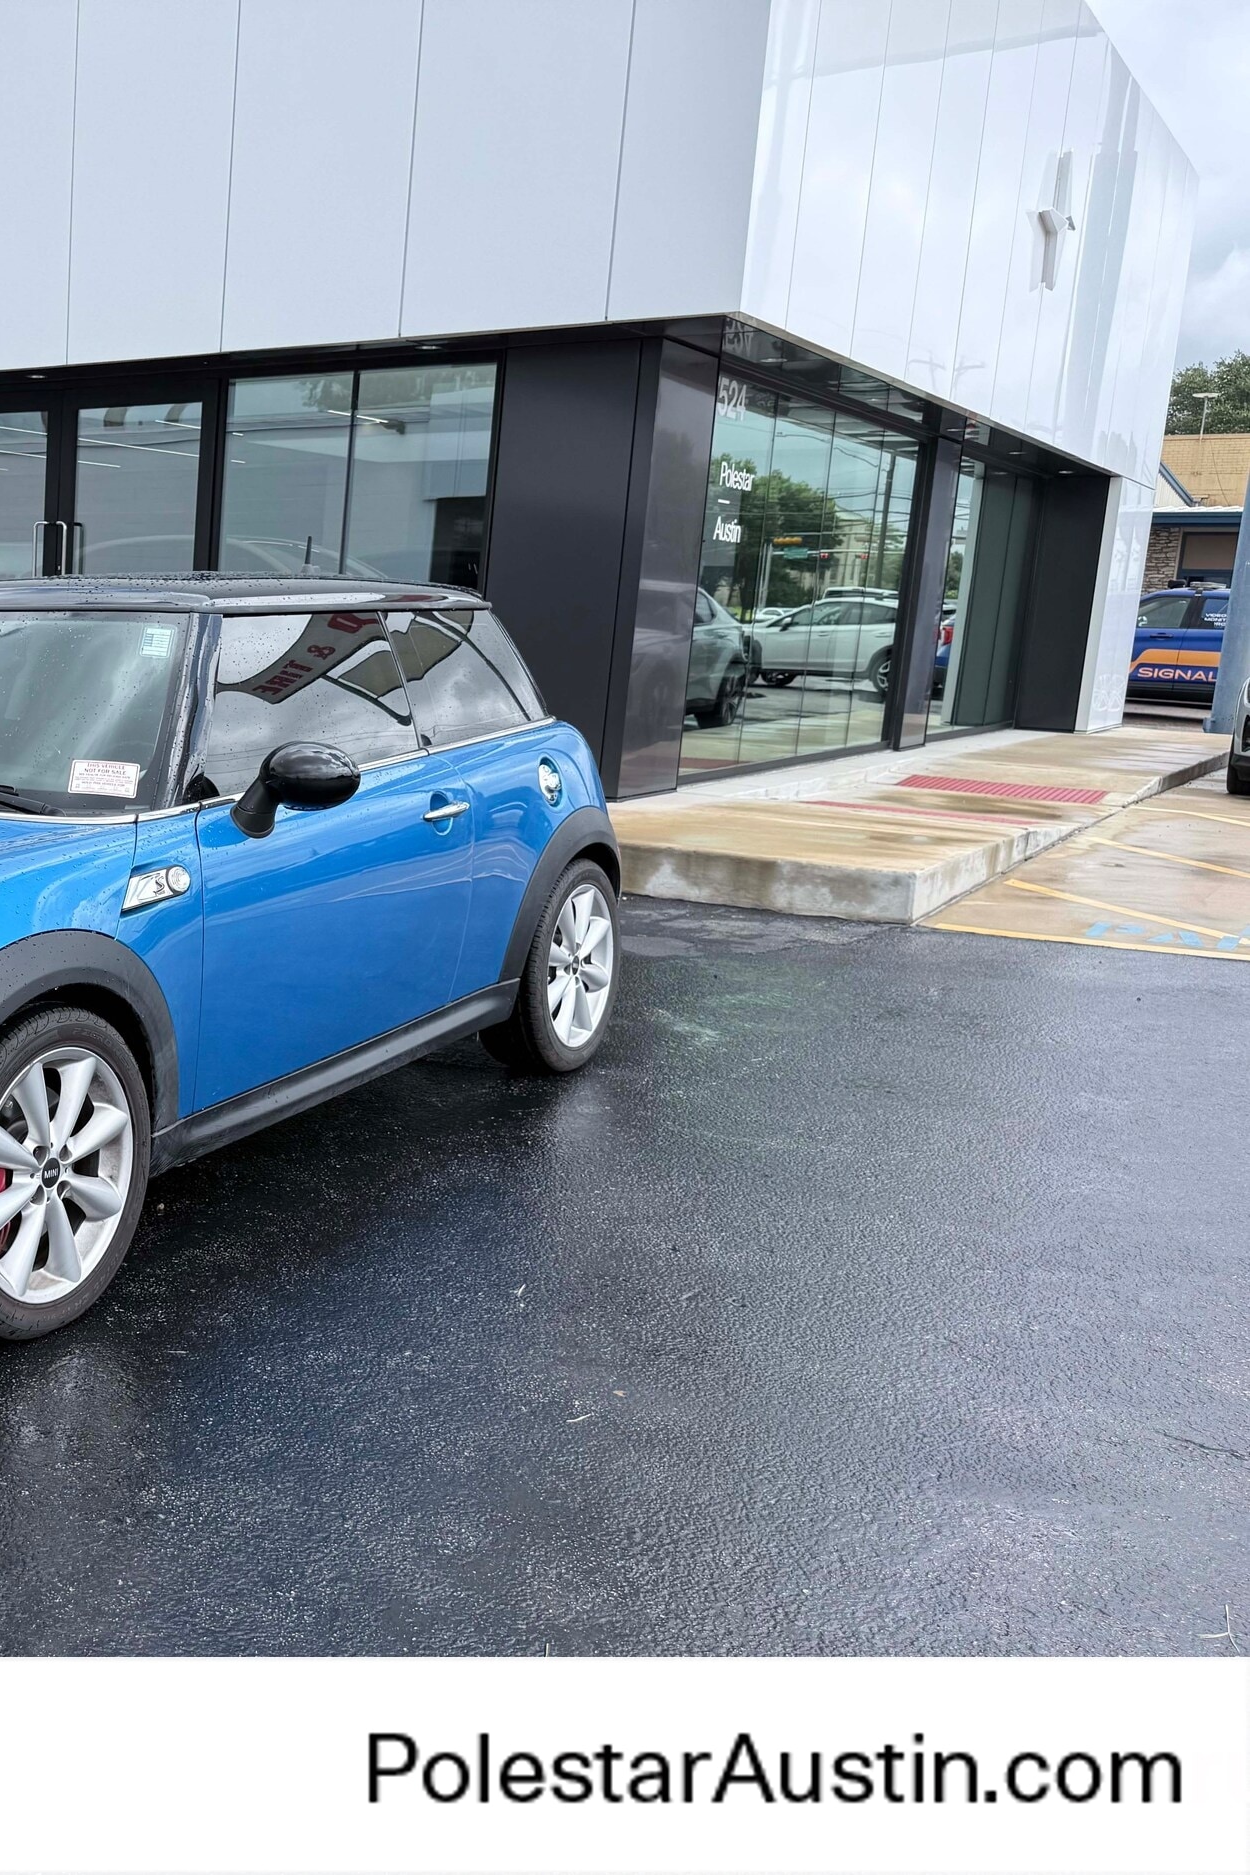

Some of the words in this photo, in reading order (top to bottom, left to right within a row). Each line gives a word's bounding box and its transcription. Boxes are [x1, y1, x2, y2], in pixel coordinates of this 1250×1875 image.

[717, 375, 747, 421] 524
[719, 461, 755, 491] Polestar
[712, 515, 742, 544] Austin
[1137, 667, 1217, 682] SIGNAL
[43, 1167, 59, 1179] MINI
